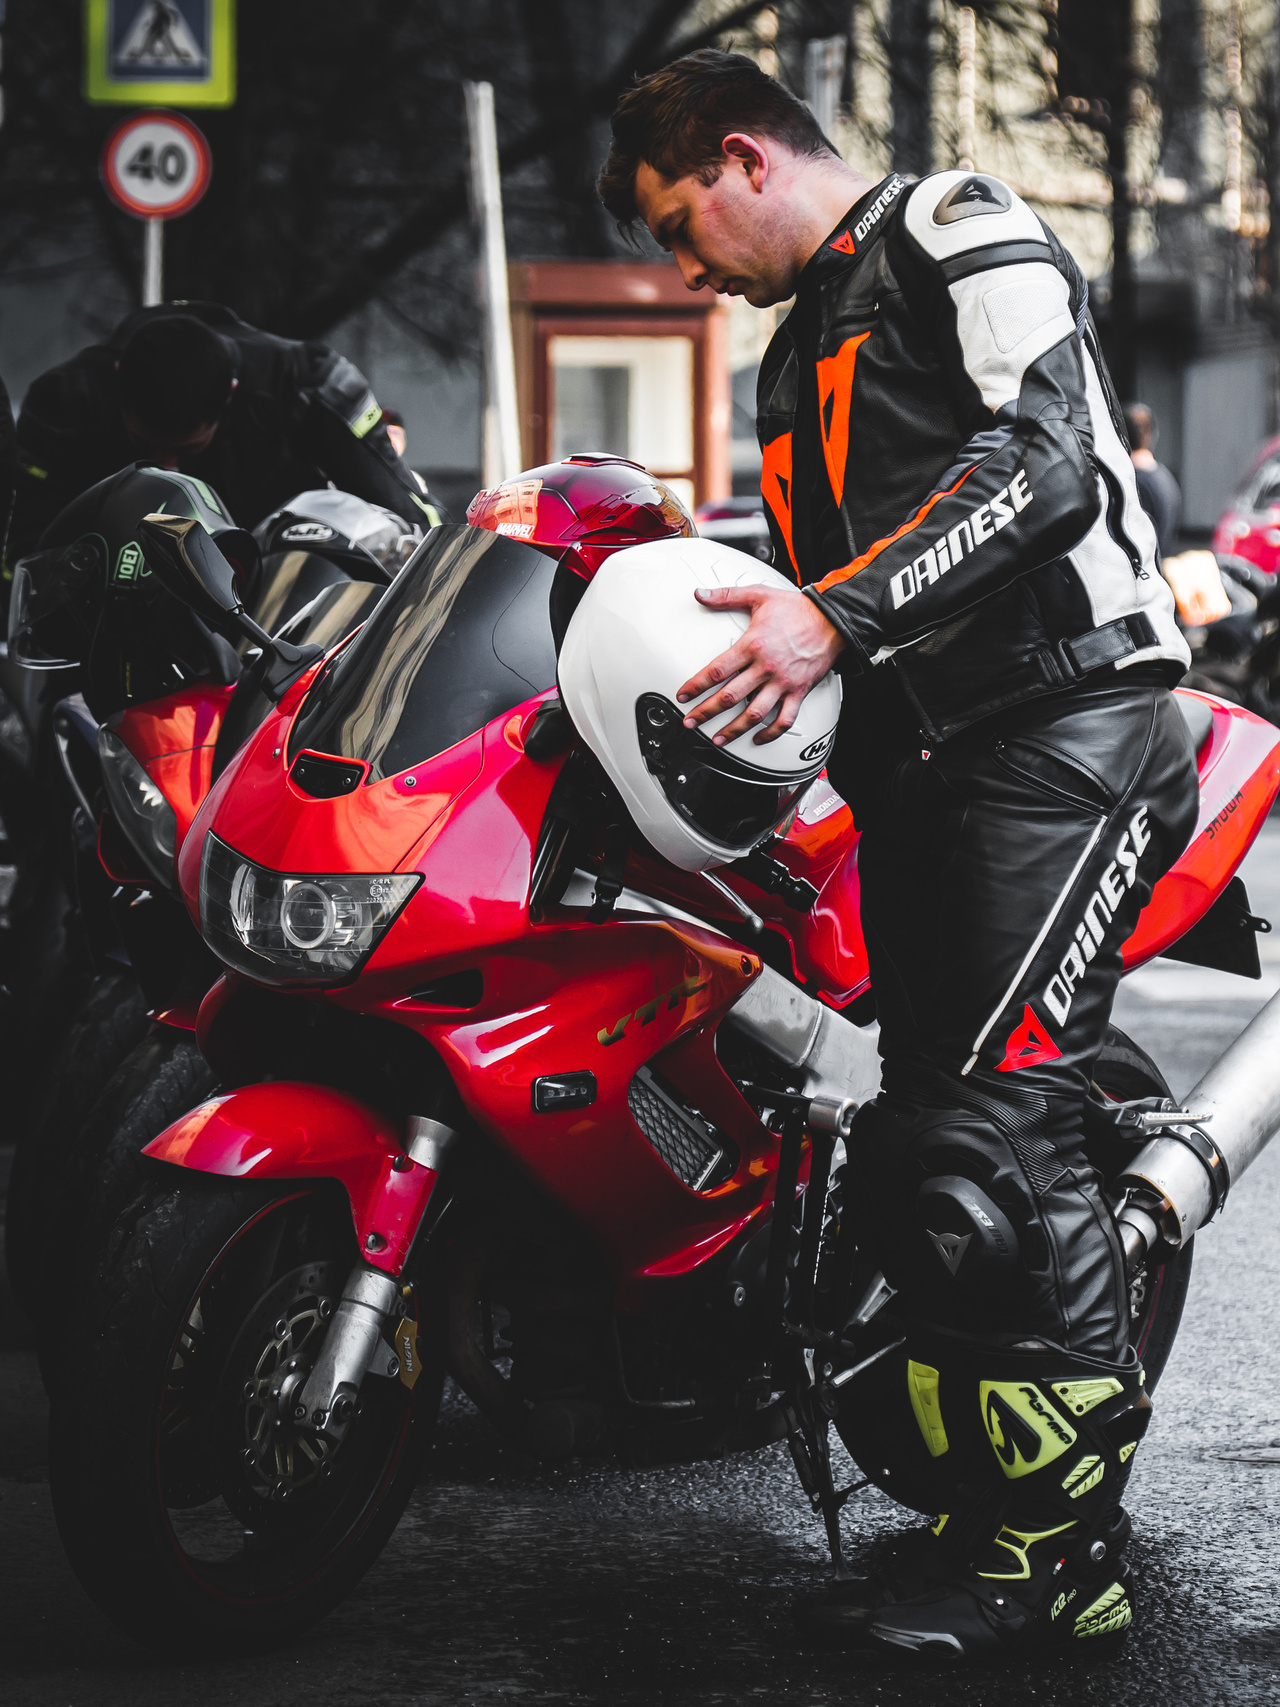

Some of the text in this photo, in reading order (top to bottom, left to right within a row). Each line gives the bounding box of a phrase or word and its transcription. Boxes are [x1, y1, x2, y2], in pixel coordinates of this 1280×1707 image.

[124, 142, 188, 187] 40
[854, 177, 905, 242] DAINESE
[496, 522, 536, 539] MARVEL
[889, 468, 1034, 610] DAINESE
[813, 794, 841, 817] HONDA
[1043, 804, 1151, 1027] DAINESE
[403, 1336, 413, 1372] NISSIN
